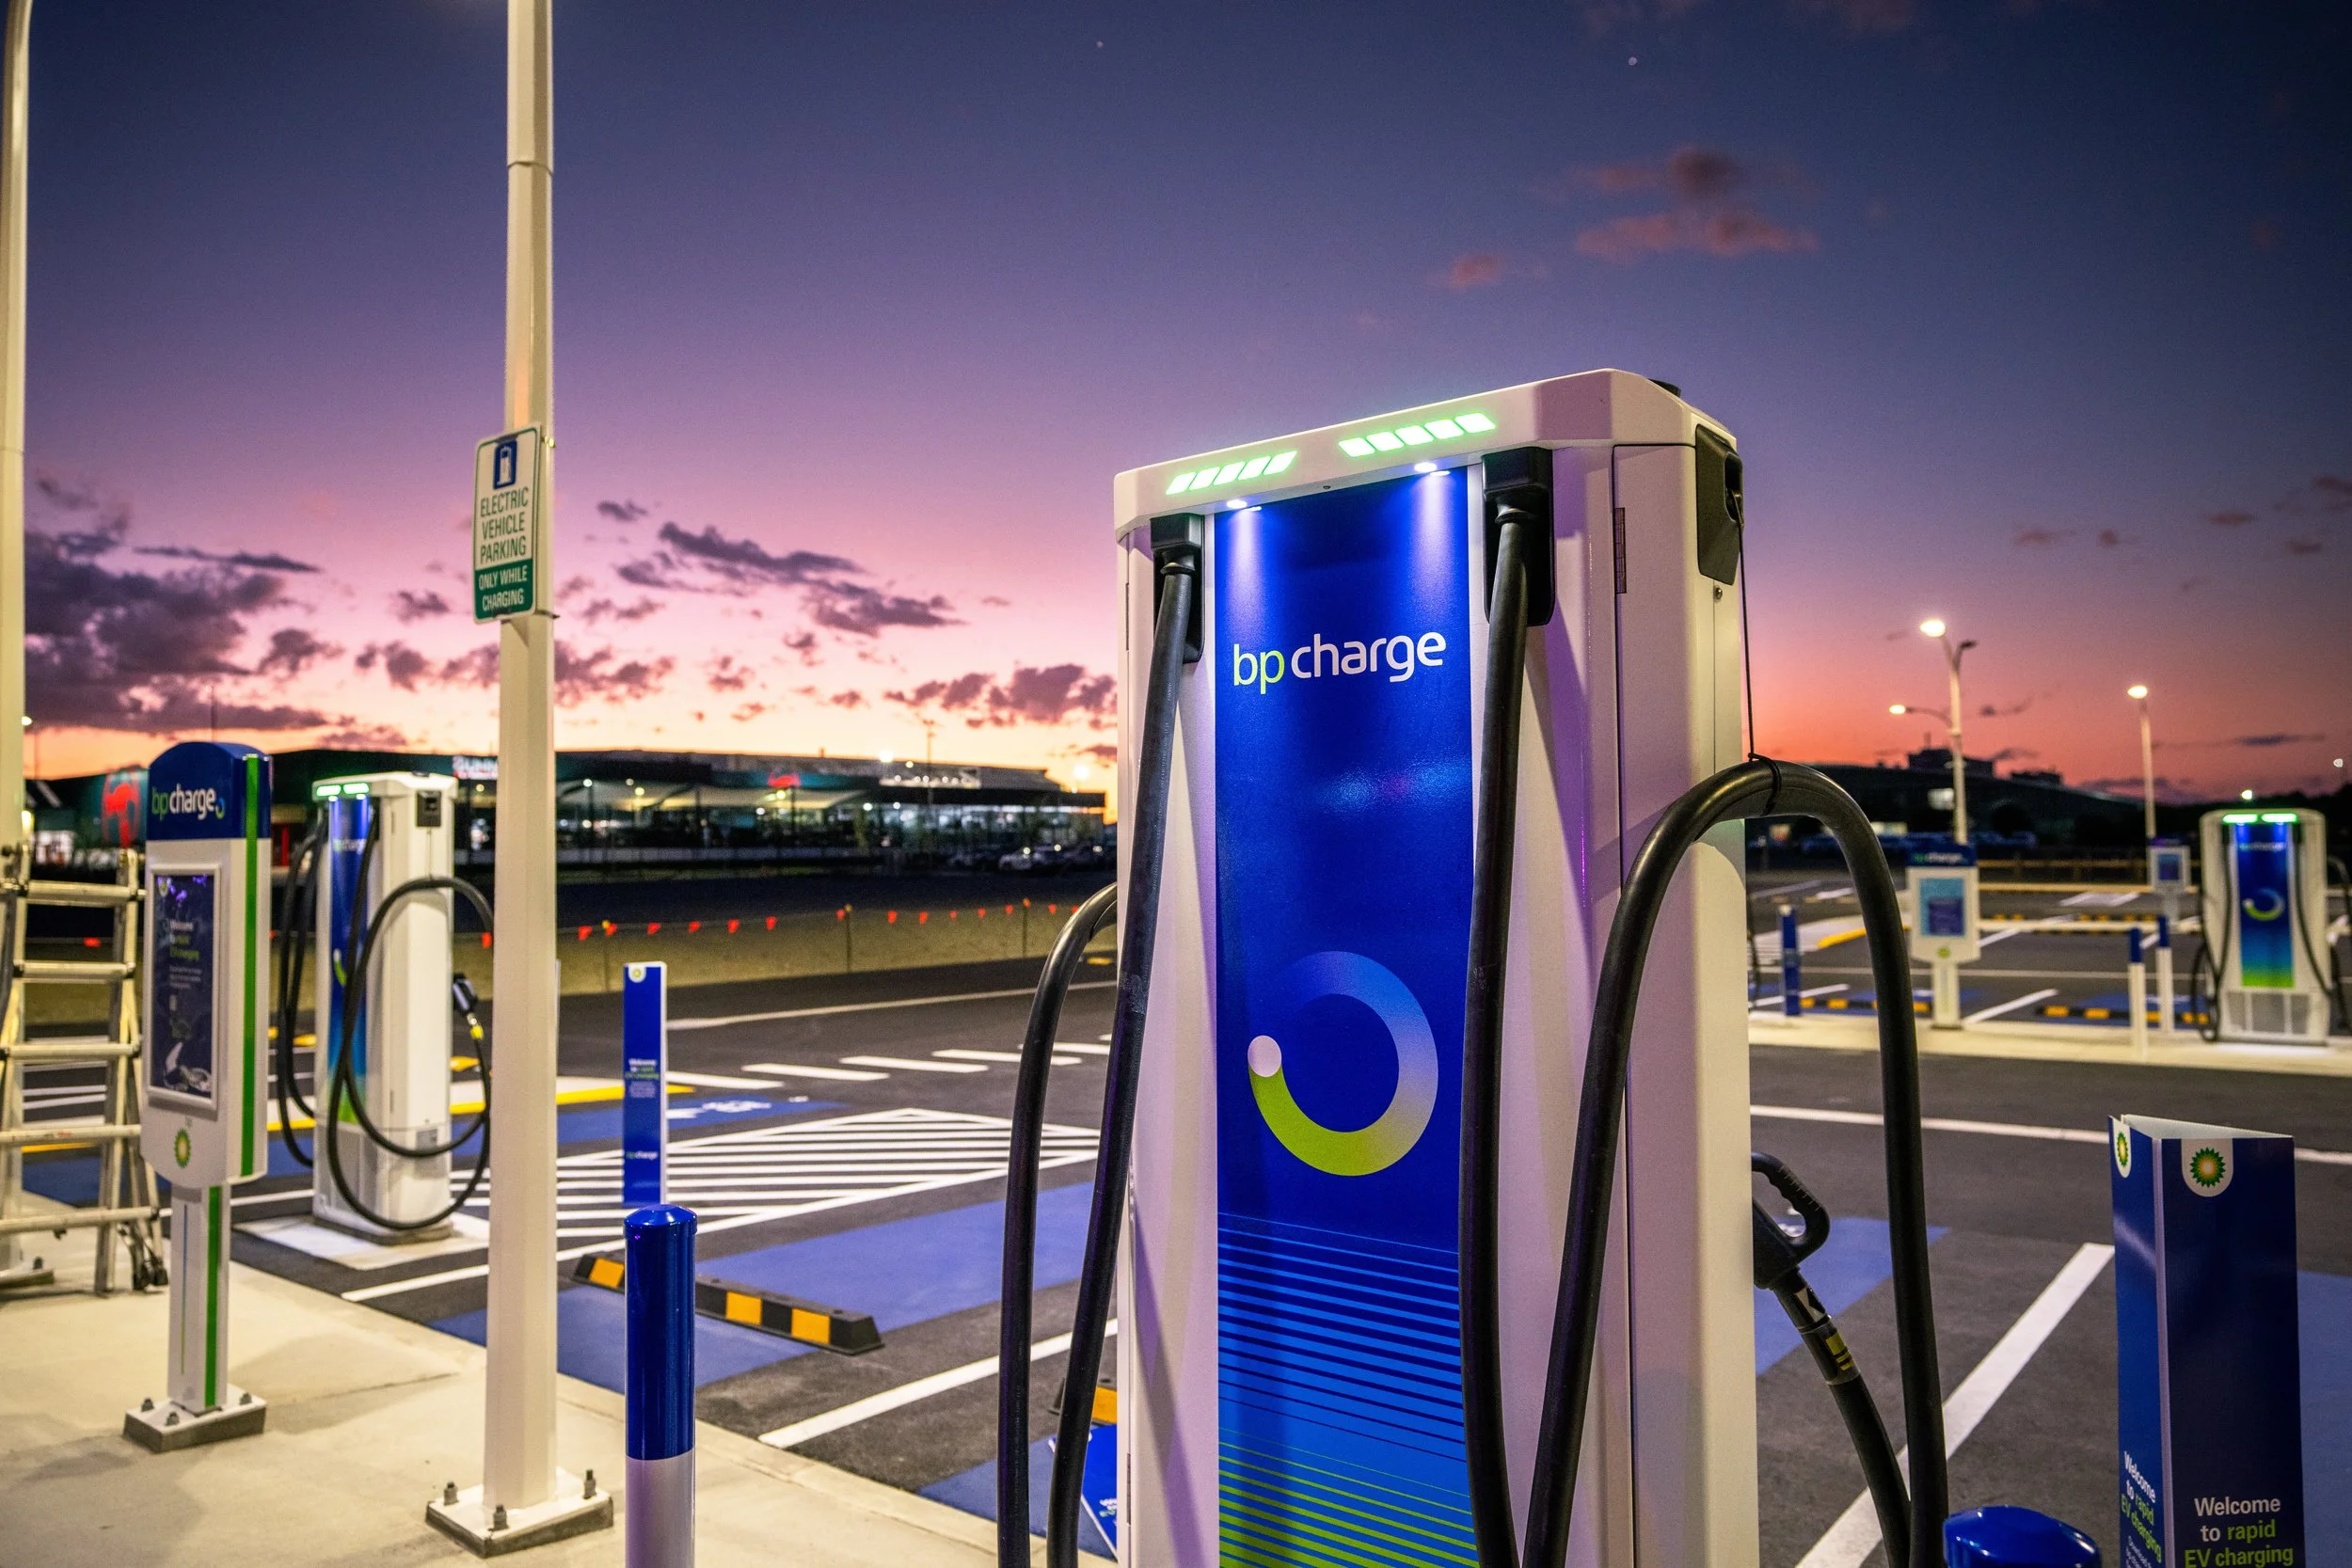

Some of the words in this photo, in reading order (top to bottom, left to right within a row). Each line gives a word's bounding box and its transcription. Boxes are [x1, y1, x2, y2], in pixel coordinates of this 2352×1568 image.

[481, 487, 529, 517] ELECTRIC
[482, 512, 525, 540] VEHICLE
[481, 535, 526, 564] PARKING
[479, 570, 498, 591] ONLY
[500, 565, 527, 585] WHILE
[482, 588, 524, 611] CHARGING
[2124, 1450, 2155, 1503] Welcome
[2194, 1497, 2280, 1516] Welcome
[2200, 1525, 2221, 1542] to
[2227, 1519, 2276, 1544] rapid
[2185, 1549, 2211, 1568] EV
[2215, 1544, 2294, 1568] charging
